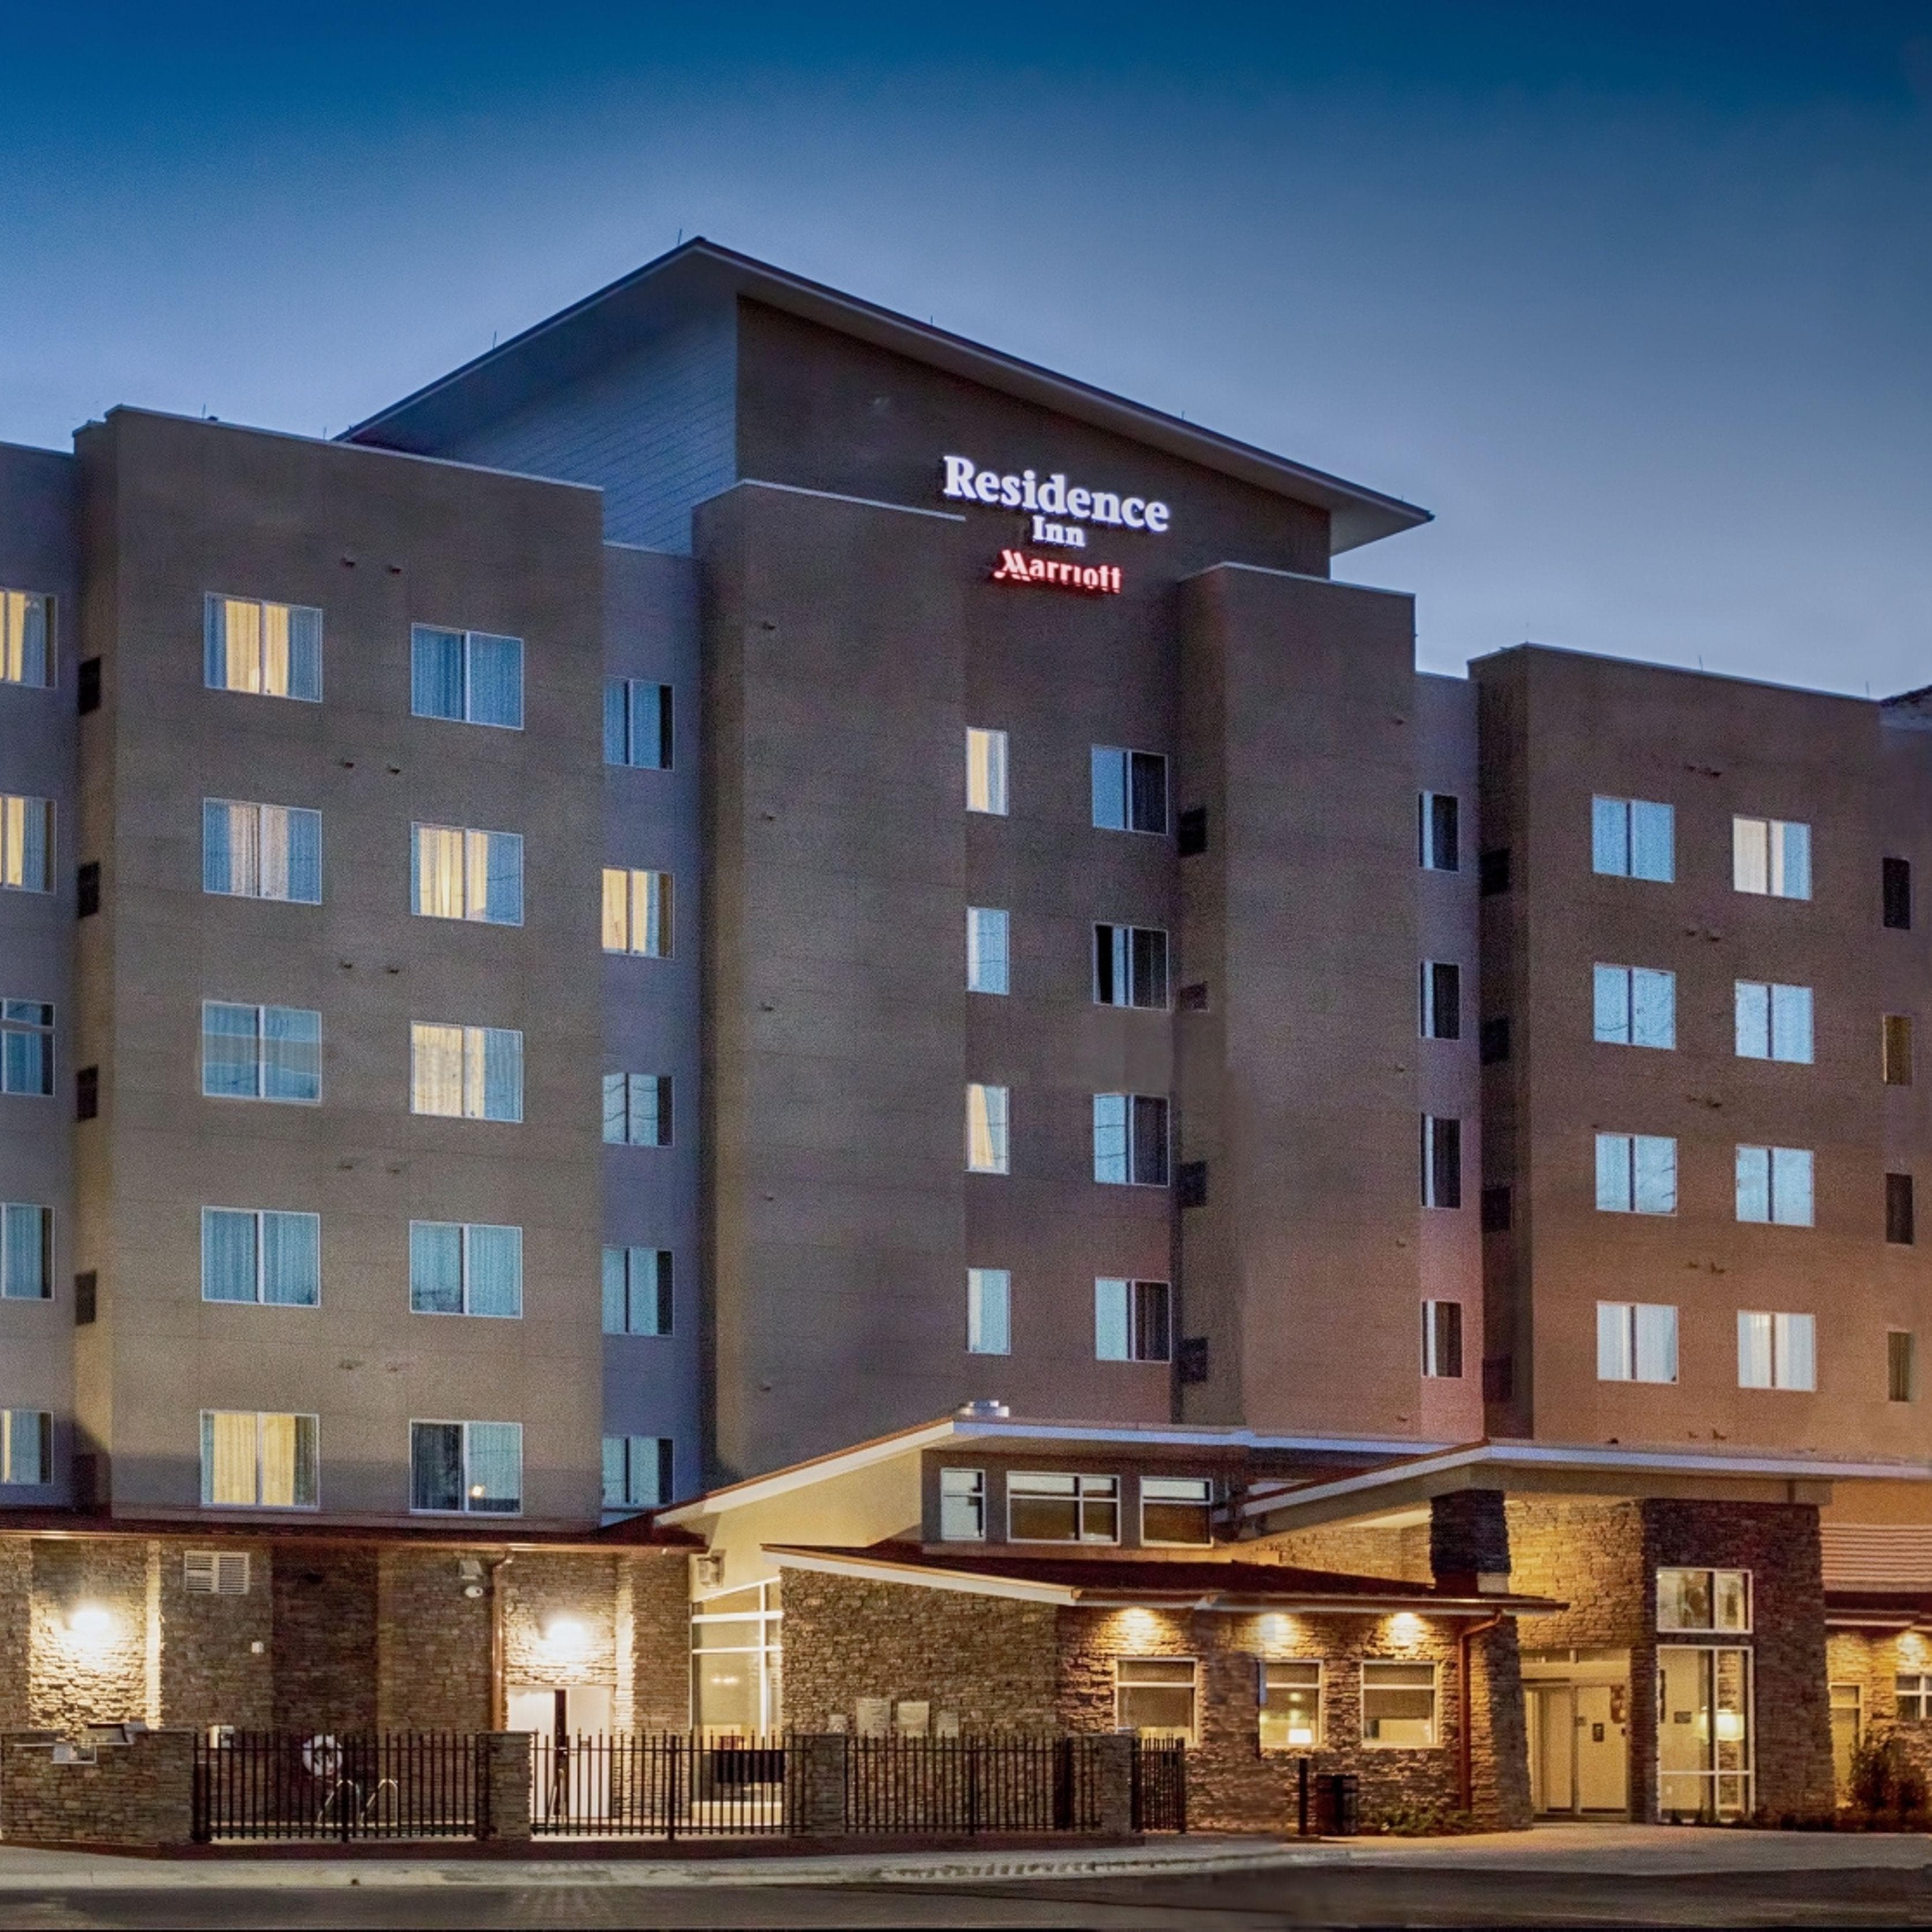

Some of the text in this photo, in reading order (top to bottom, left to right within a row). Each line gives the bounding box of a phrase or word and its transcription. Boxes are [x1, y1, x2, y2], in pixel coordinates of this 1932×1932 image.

[943, 455, 1170, 533] Residence
[1032, 515, 1086, 548] Inn
[993, 549, 1122, 594] Marriott
